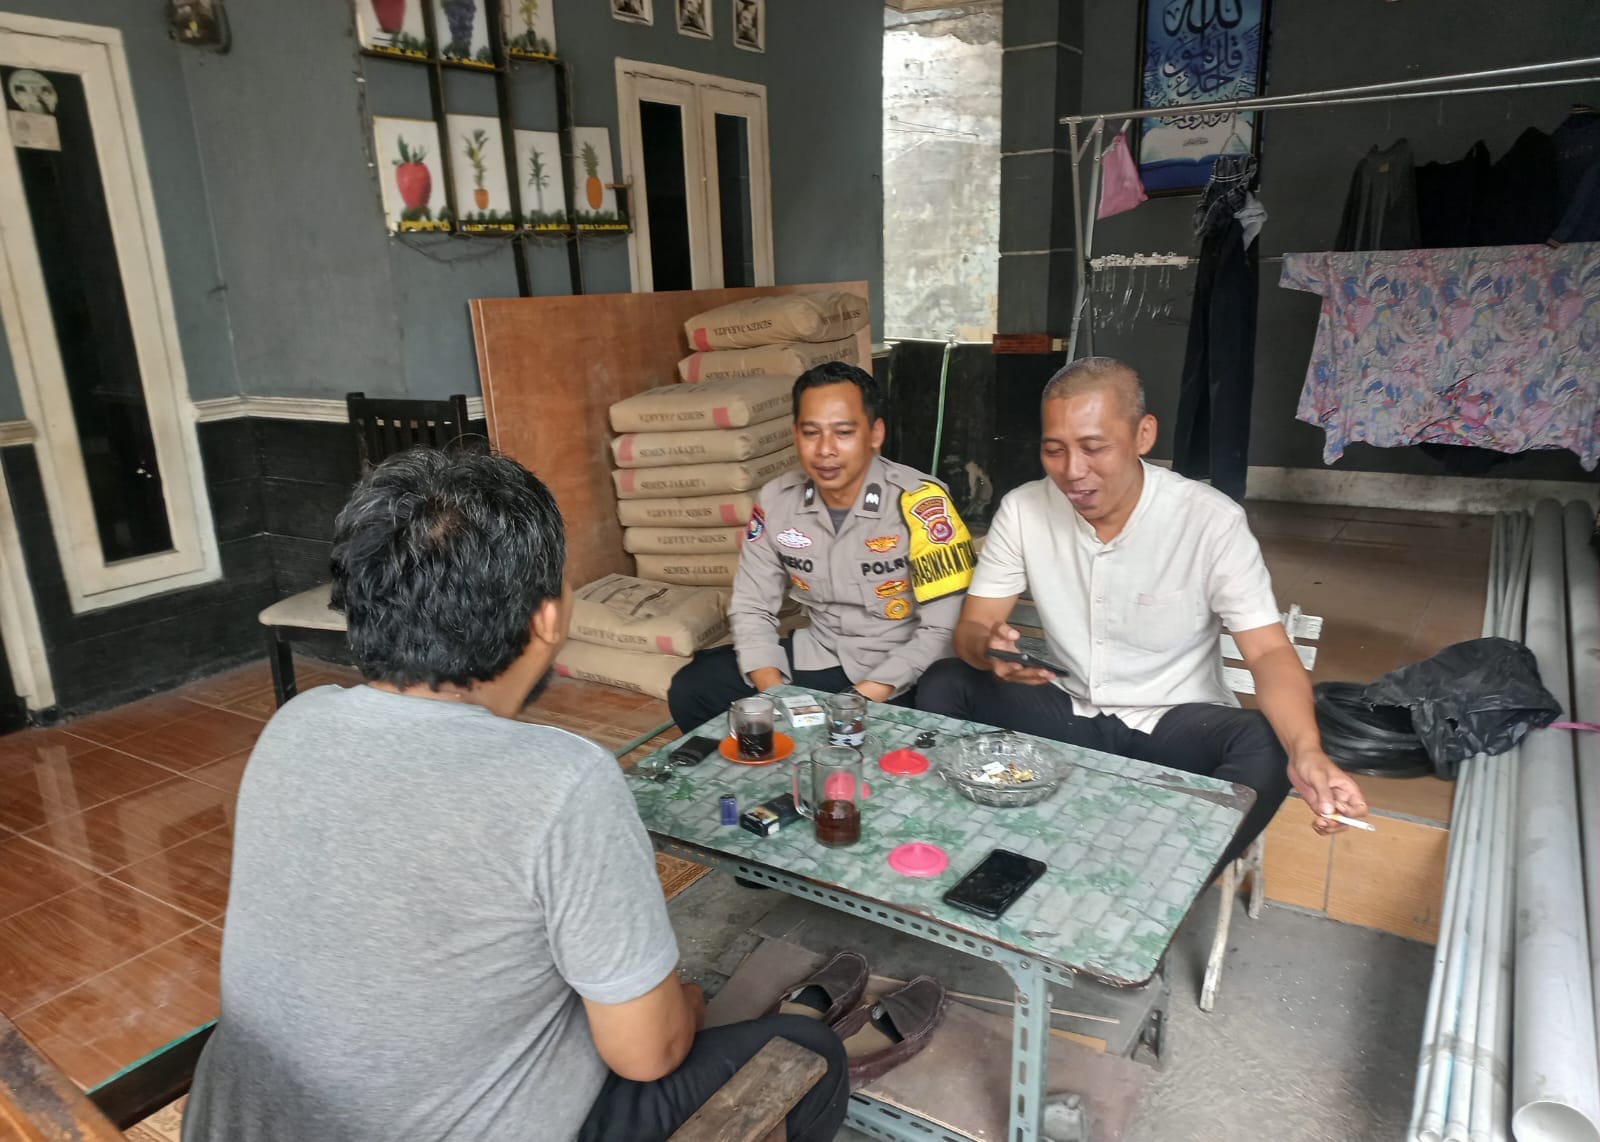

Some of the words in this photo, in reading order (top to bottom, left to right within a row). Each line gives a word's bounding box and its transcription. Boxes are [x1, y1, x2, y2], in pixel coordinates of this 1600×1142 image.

[705, 370, 731, 381] SEMEN
[639, 448, 666, 458] SEMEN
[640, 479, 666, 489] SEMEN
[663, 565, 690, 575] SEMEN
[692, 565, 729, 575] JAKARTA
